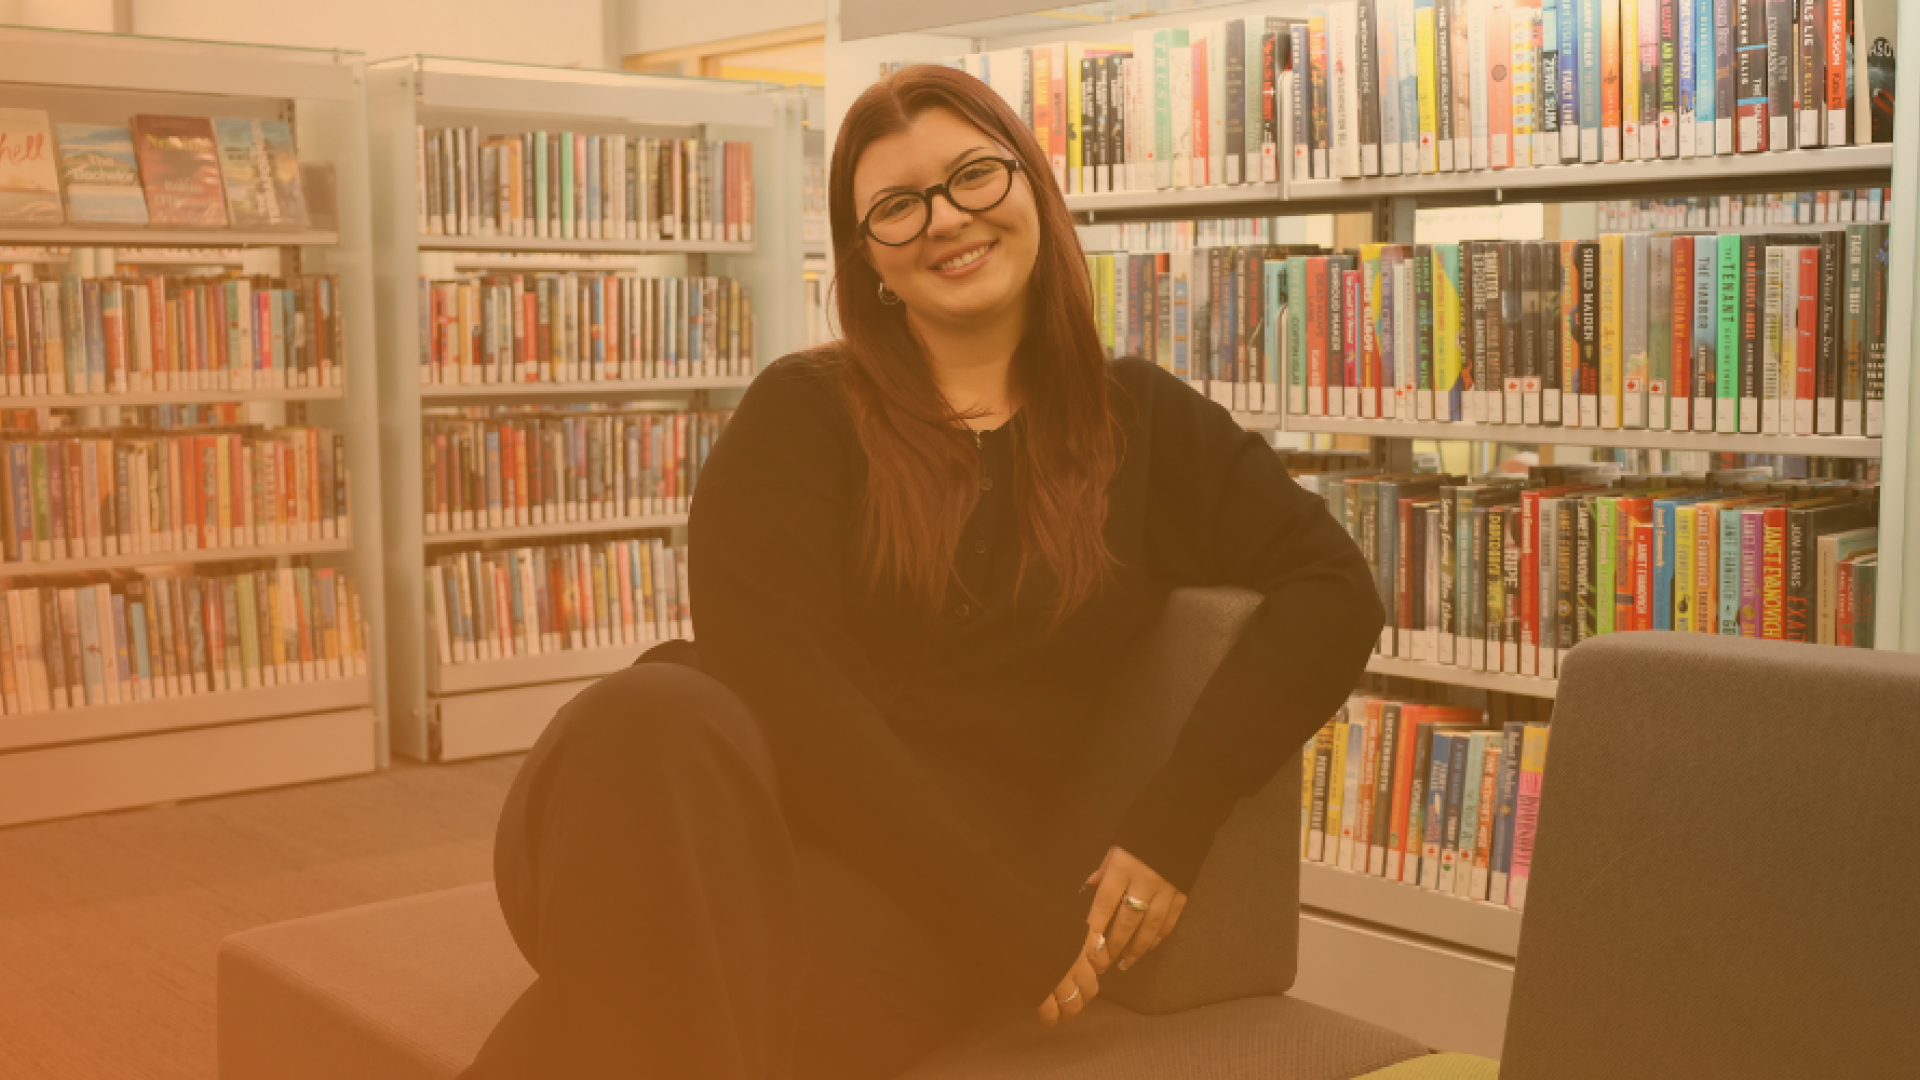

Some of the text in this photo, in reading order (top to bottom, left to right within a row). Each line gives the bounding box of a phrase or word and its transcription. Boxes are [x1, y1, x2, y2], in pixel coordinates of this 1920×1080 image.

[1441, 78, 1449, 140] COLLECTOR
[1544, 97, 1555, 130] SUM
[1337, 133, 1346, 147] BLA
[1698, 257, 1709, 278] THE
[1583, 247, 1593, 341] SHIELD MAIDEN
[1722, 263, 1734, 322] TENANT
[1291, 361, 1299, 385] ISLAN
[1790, 523, 1800, 546] JON
[1503, 548, 1518, 588] RIPE
[1723, 517, 1736, 601] JANET EVANOVICH
[1742, 518, 1754, 598] JANET EVANOVICH
[1790, 550, 1800, 588] EVANS
[1763, 522, 1781, 638] JANET EVANOVICH
[1440, 602, 1452, 633] Esken
